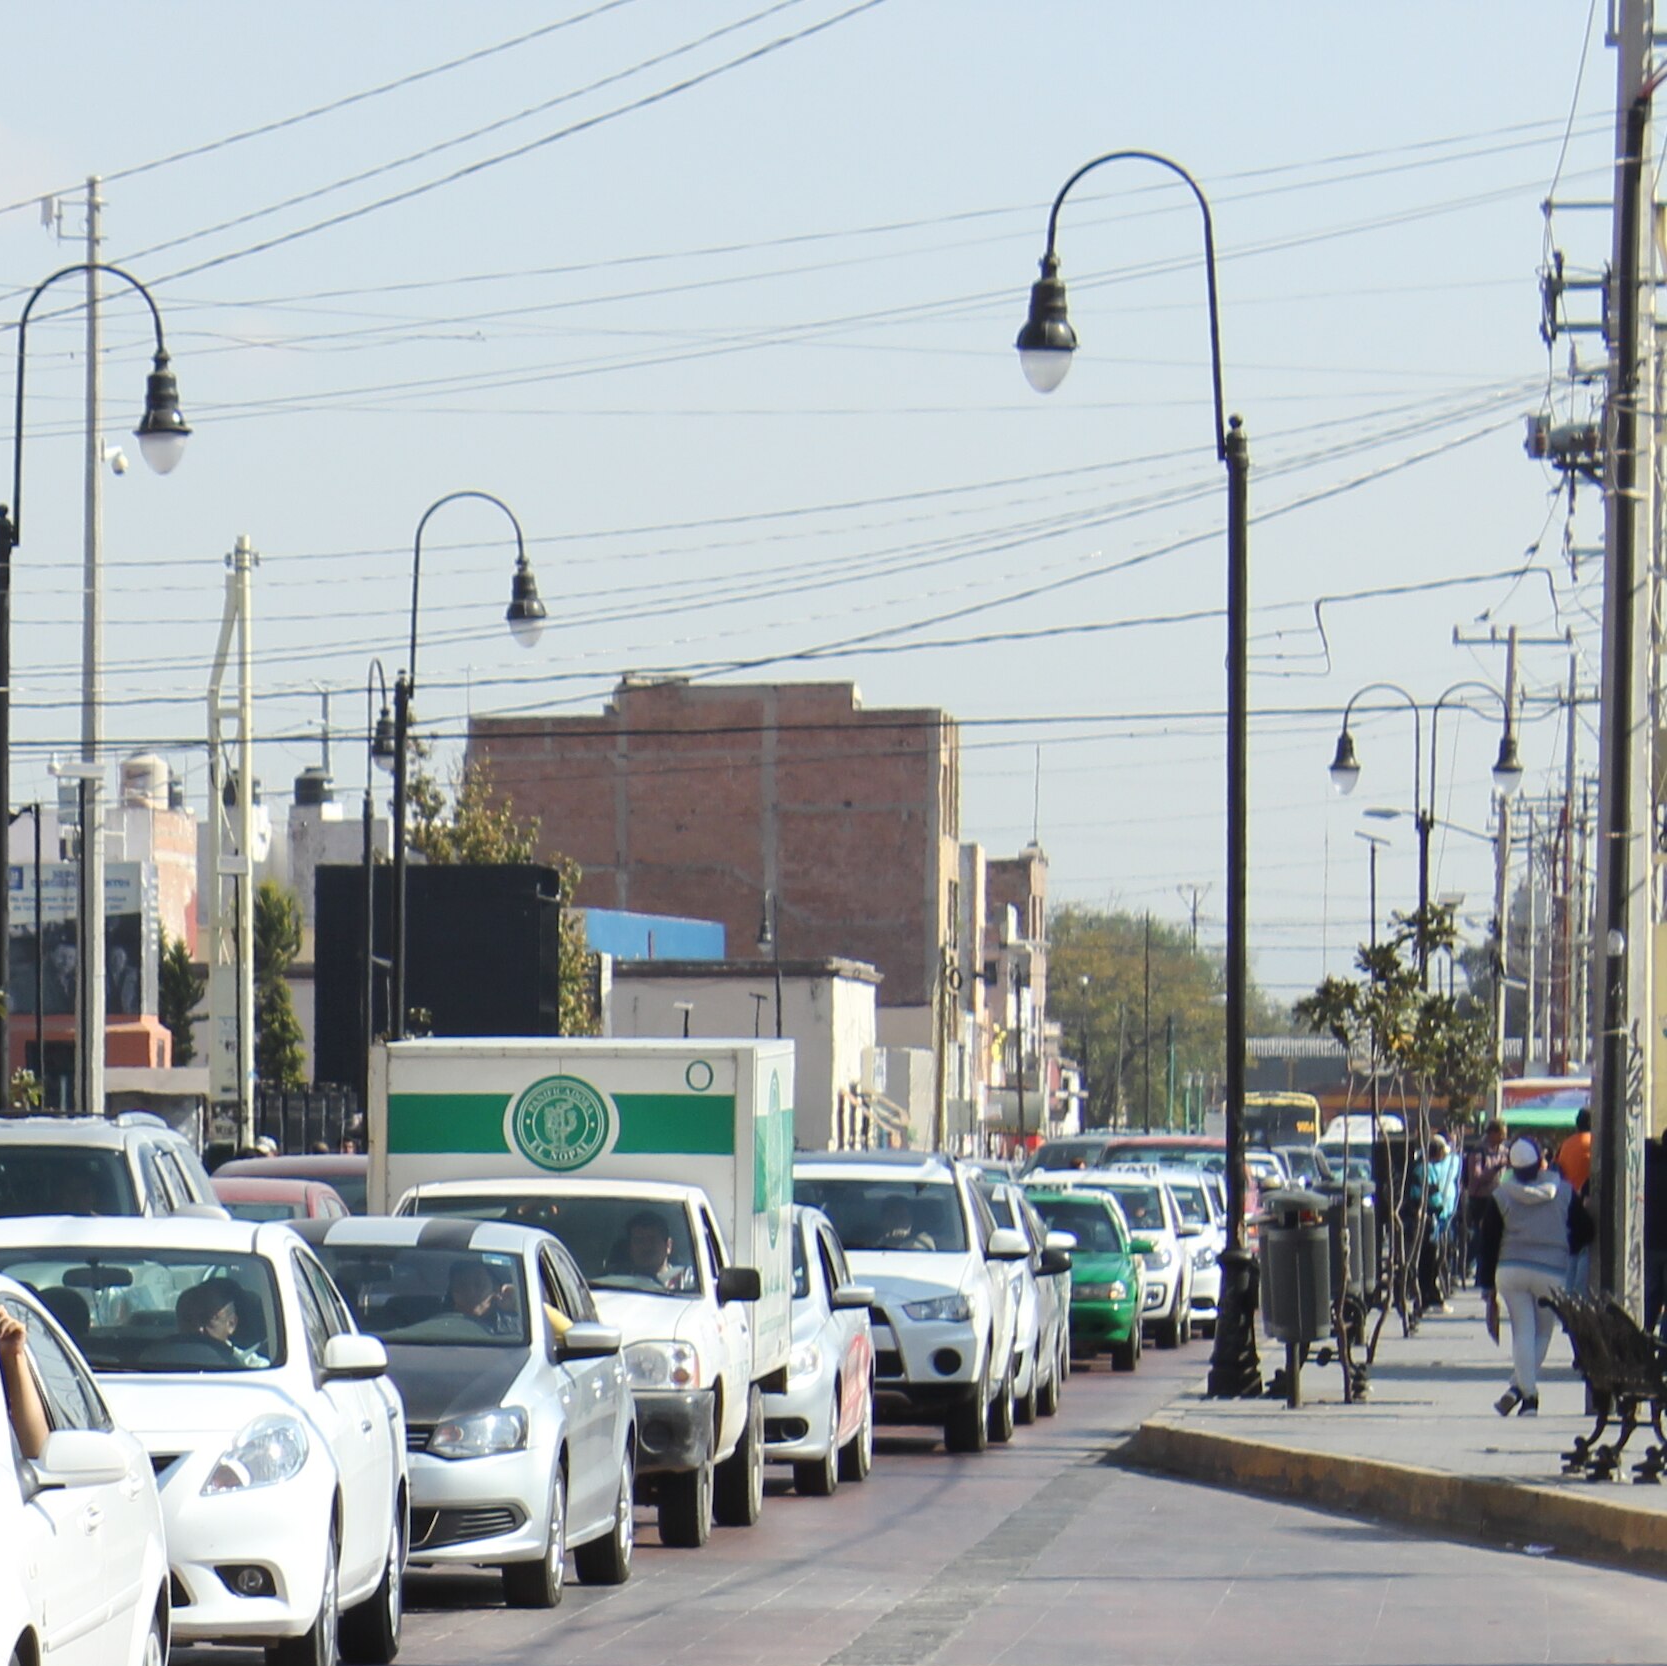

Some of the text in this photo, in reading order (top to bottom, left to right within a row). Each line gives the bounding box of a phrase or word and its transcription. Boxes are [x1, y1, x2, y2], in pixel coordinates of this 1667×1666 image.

[527, 1086, 594, 1115] PANIFICADORA
[529, 1138, 592, 1162] EL NOPAL
